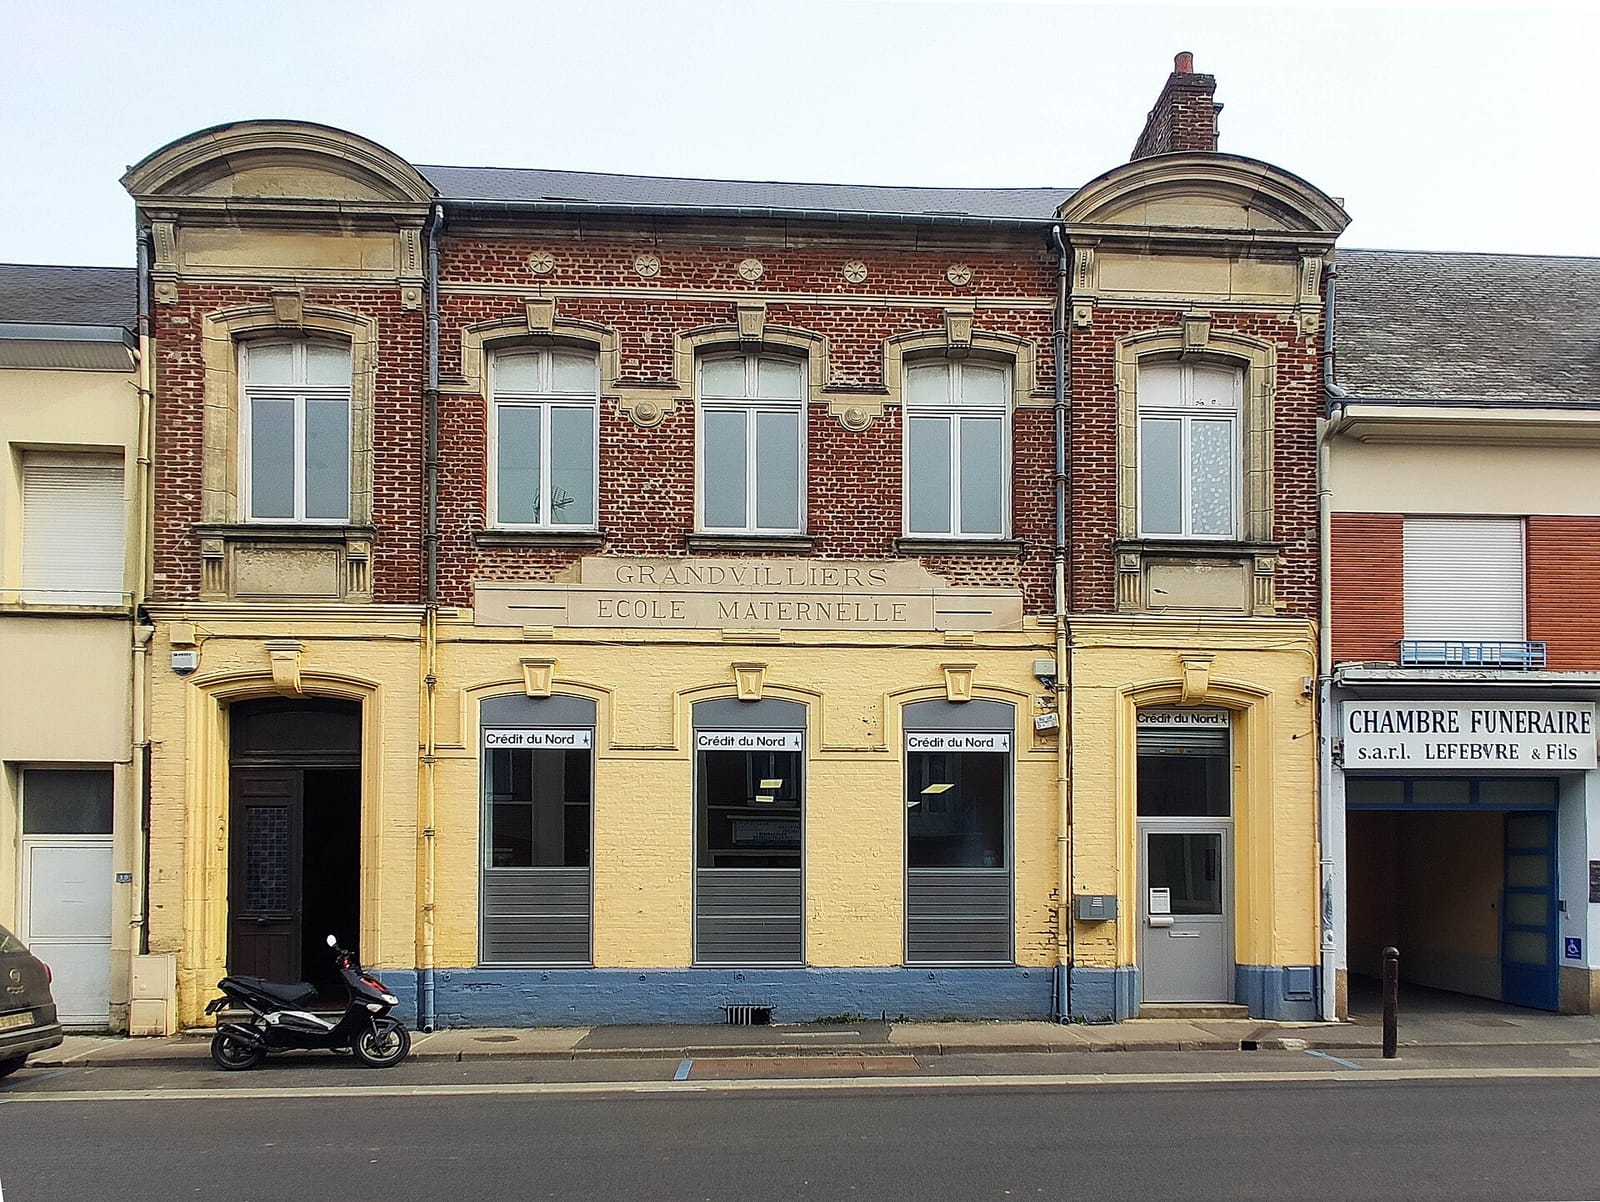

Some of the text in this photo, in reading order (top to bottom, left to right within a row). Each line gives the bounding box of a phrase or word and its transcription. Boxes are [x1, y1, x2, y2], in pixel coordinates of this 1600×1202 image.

[615, 565, 888, 587] GRANDVILLIERS
[597, 599, 908, 622] ECOLE MATERNELLE
[1137, 713, 1218, 723] Crédit du Nord
[1349, 709, 1592, 734] CHAMBRE FUNERAIRE
[486, 733, 575, 744] Crédit du Nord
[699, 735, 786, 746] Crédit du Nord
[909, 737, 994, 747] Crédit du Nord
[1358, 742, 1577, 760] s.a.r.l. LEFEBVRE & Fils
